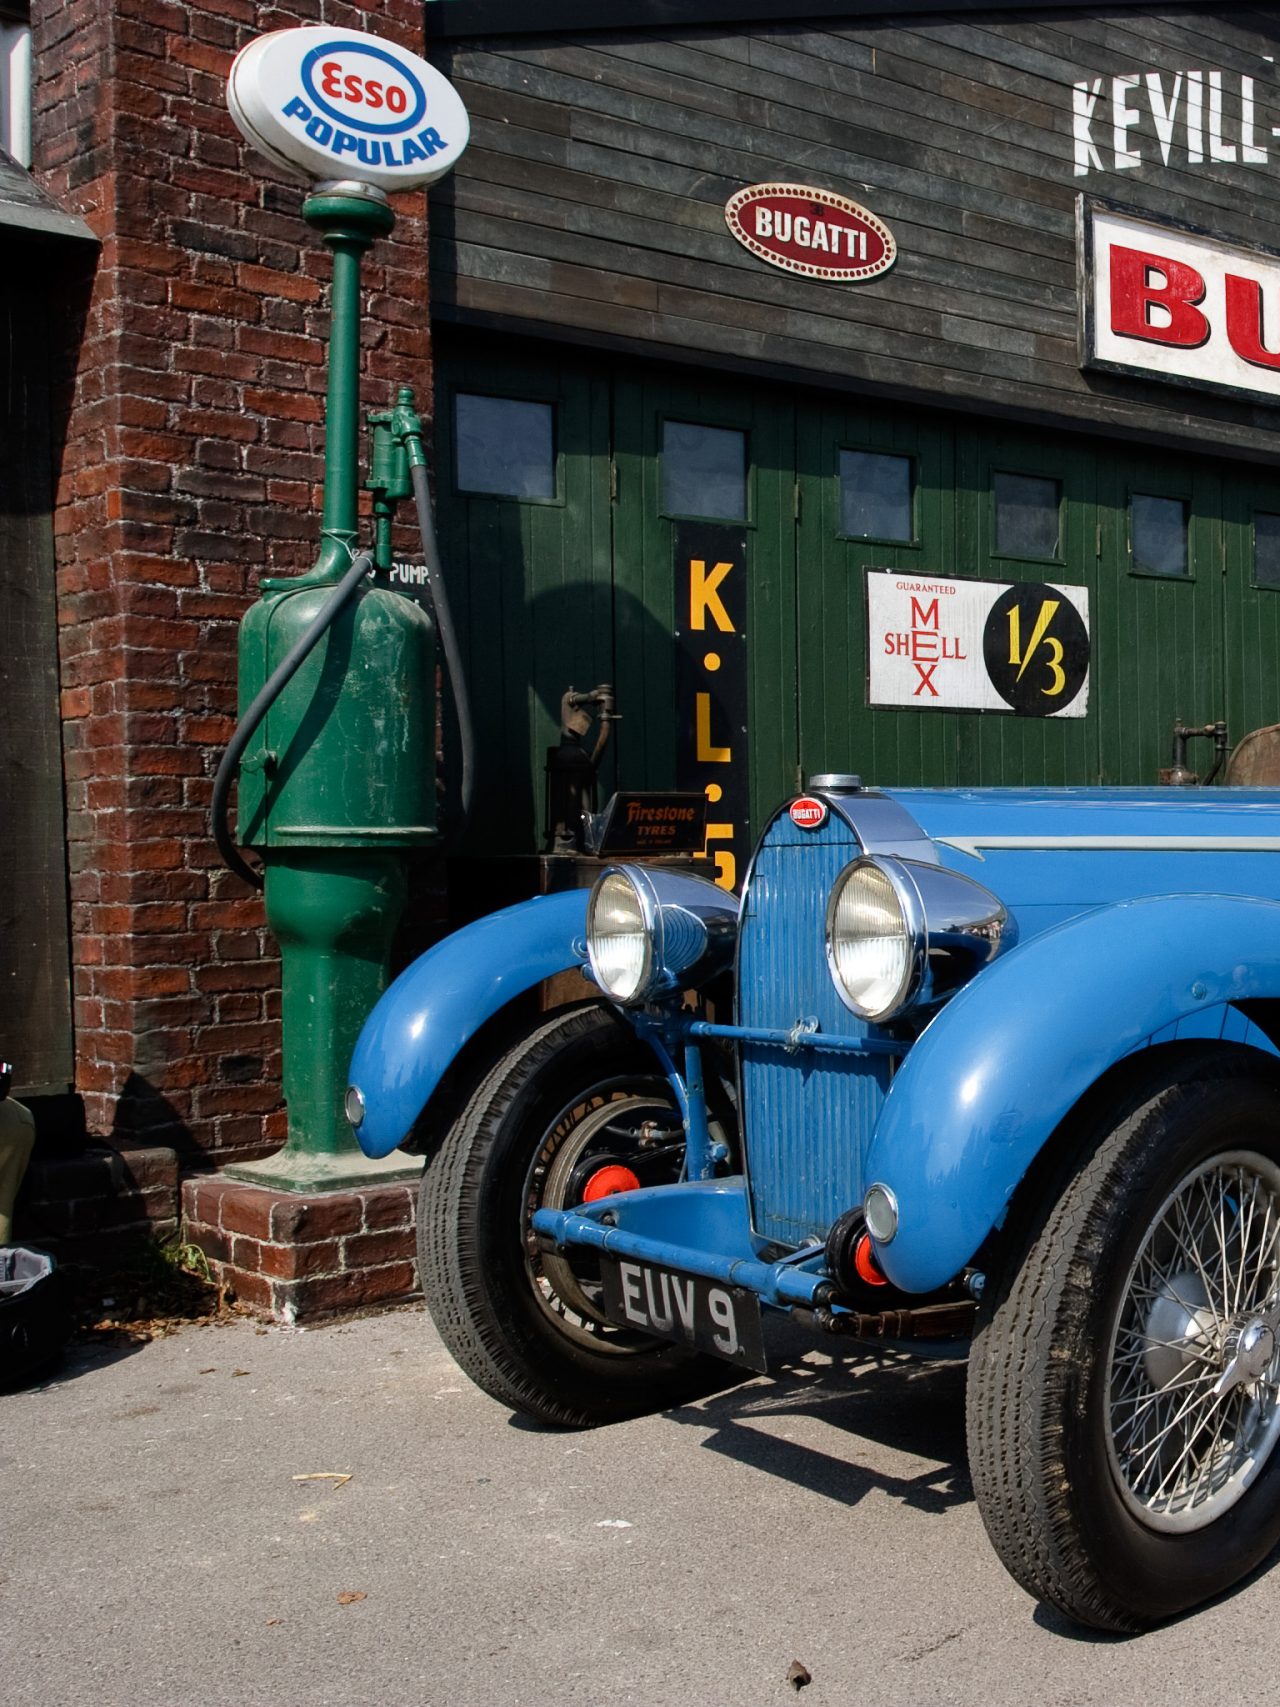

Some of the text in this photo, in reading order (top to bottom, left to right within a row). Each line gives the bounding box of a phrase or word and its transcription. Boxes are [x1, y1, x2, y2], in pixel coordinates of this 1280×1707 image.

[281, 96, 448, 167] POPULAR
[755, 206, 867, 261] BUGATTI
[390, 563, 432, 585] PUMP
[896, 581, 956, 595] GUARANTEED
[884, 631, 967, 662] SHELL
[1006, 600, 1066, 696] 1/3
[624, 801, 696, 826] Firestone
[636, 825, 678, 836] TYRES
[620, 1261, 738, 1355] EUV 9
